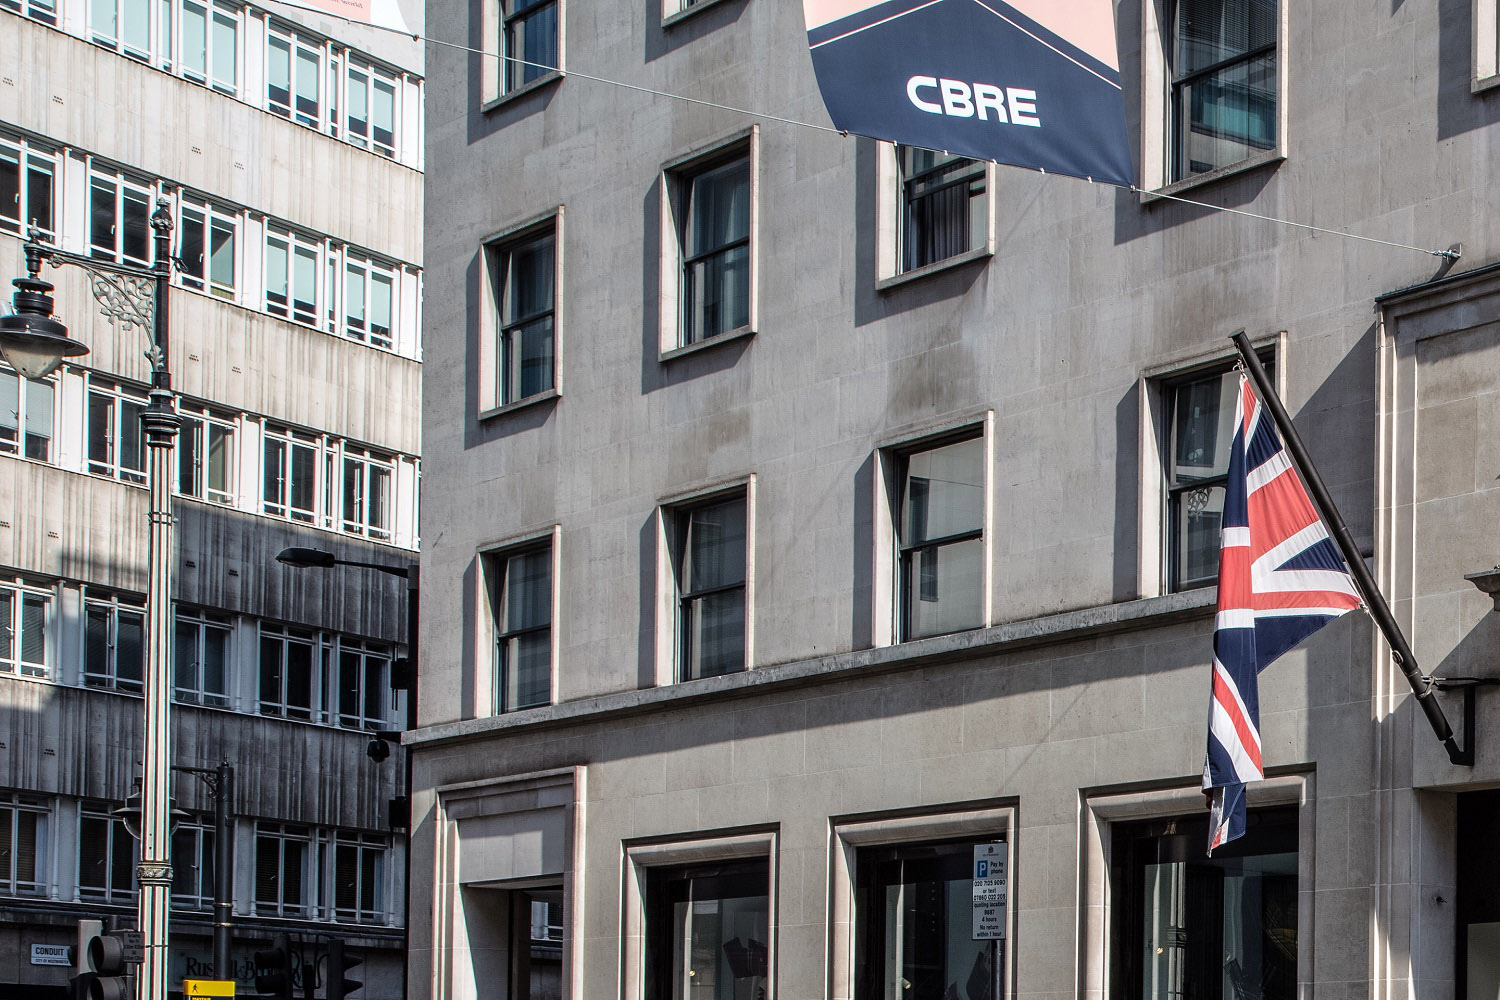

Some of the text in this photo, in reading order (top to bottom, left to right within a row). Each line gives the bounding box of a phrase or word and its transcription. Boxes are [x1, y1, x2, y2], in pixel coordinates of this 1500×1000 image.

[906, 75, 1041, 128] CBRE
[980, 862, 986, 876] P
[36, 947, 64, 956] CONDUIT
